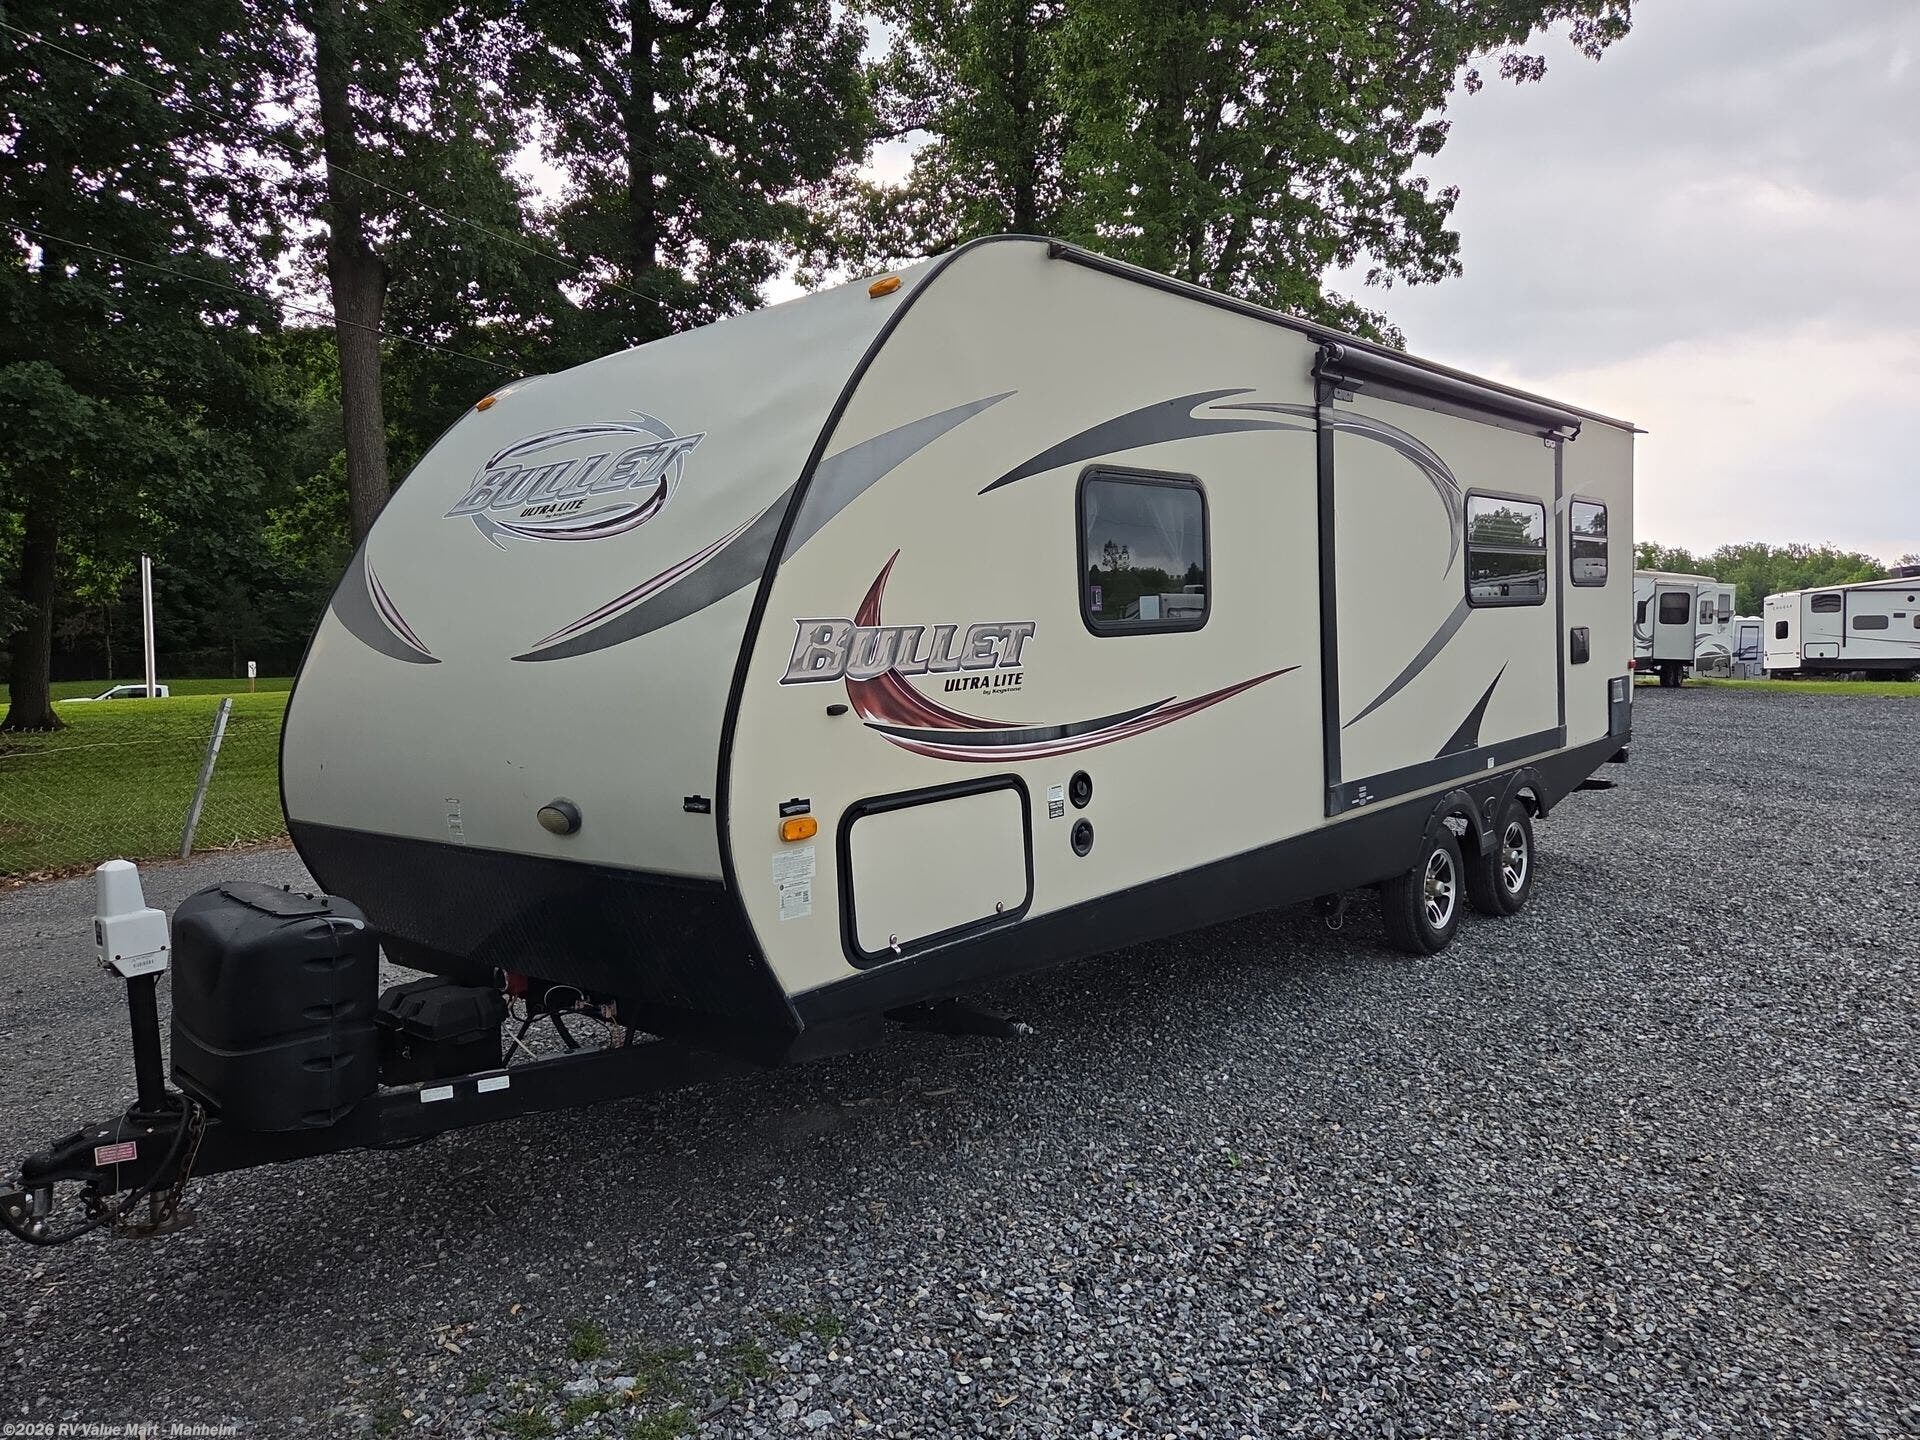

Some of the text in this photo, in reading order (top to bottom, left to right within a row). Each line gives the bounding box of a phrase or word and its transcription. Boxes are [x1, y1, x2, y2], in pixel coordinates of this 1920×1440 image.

[444, 433, 706, 518] BULLET
[520, 498, 588, 518] ULTRA LITE
[778, 618, 1037, 686] BULLET
[944, 672, 1024, 692] ULTRA LITE
[992, 686, 1022, 694] Keystone
